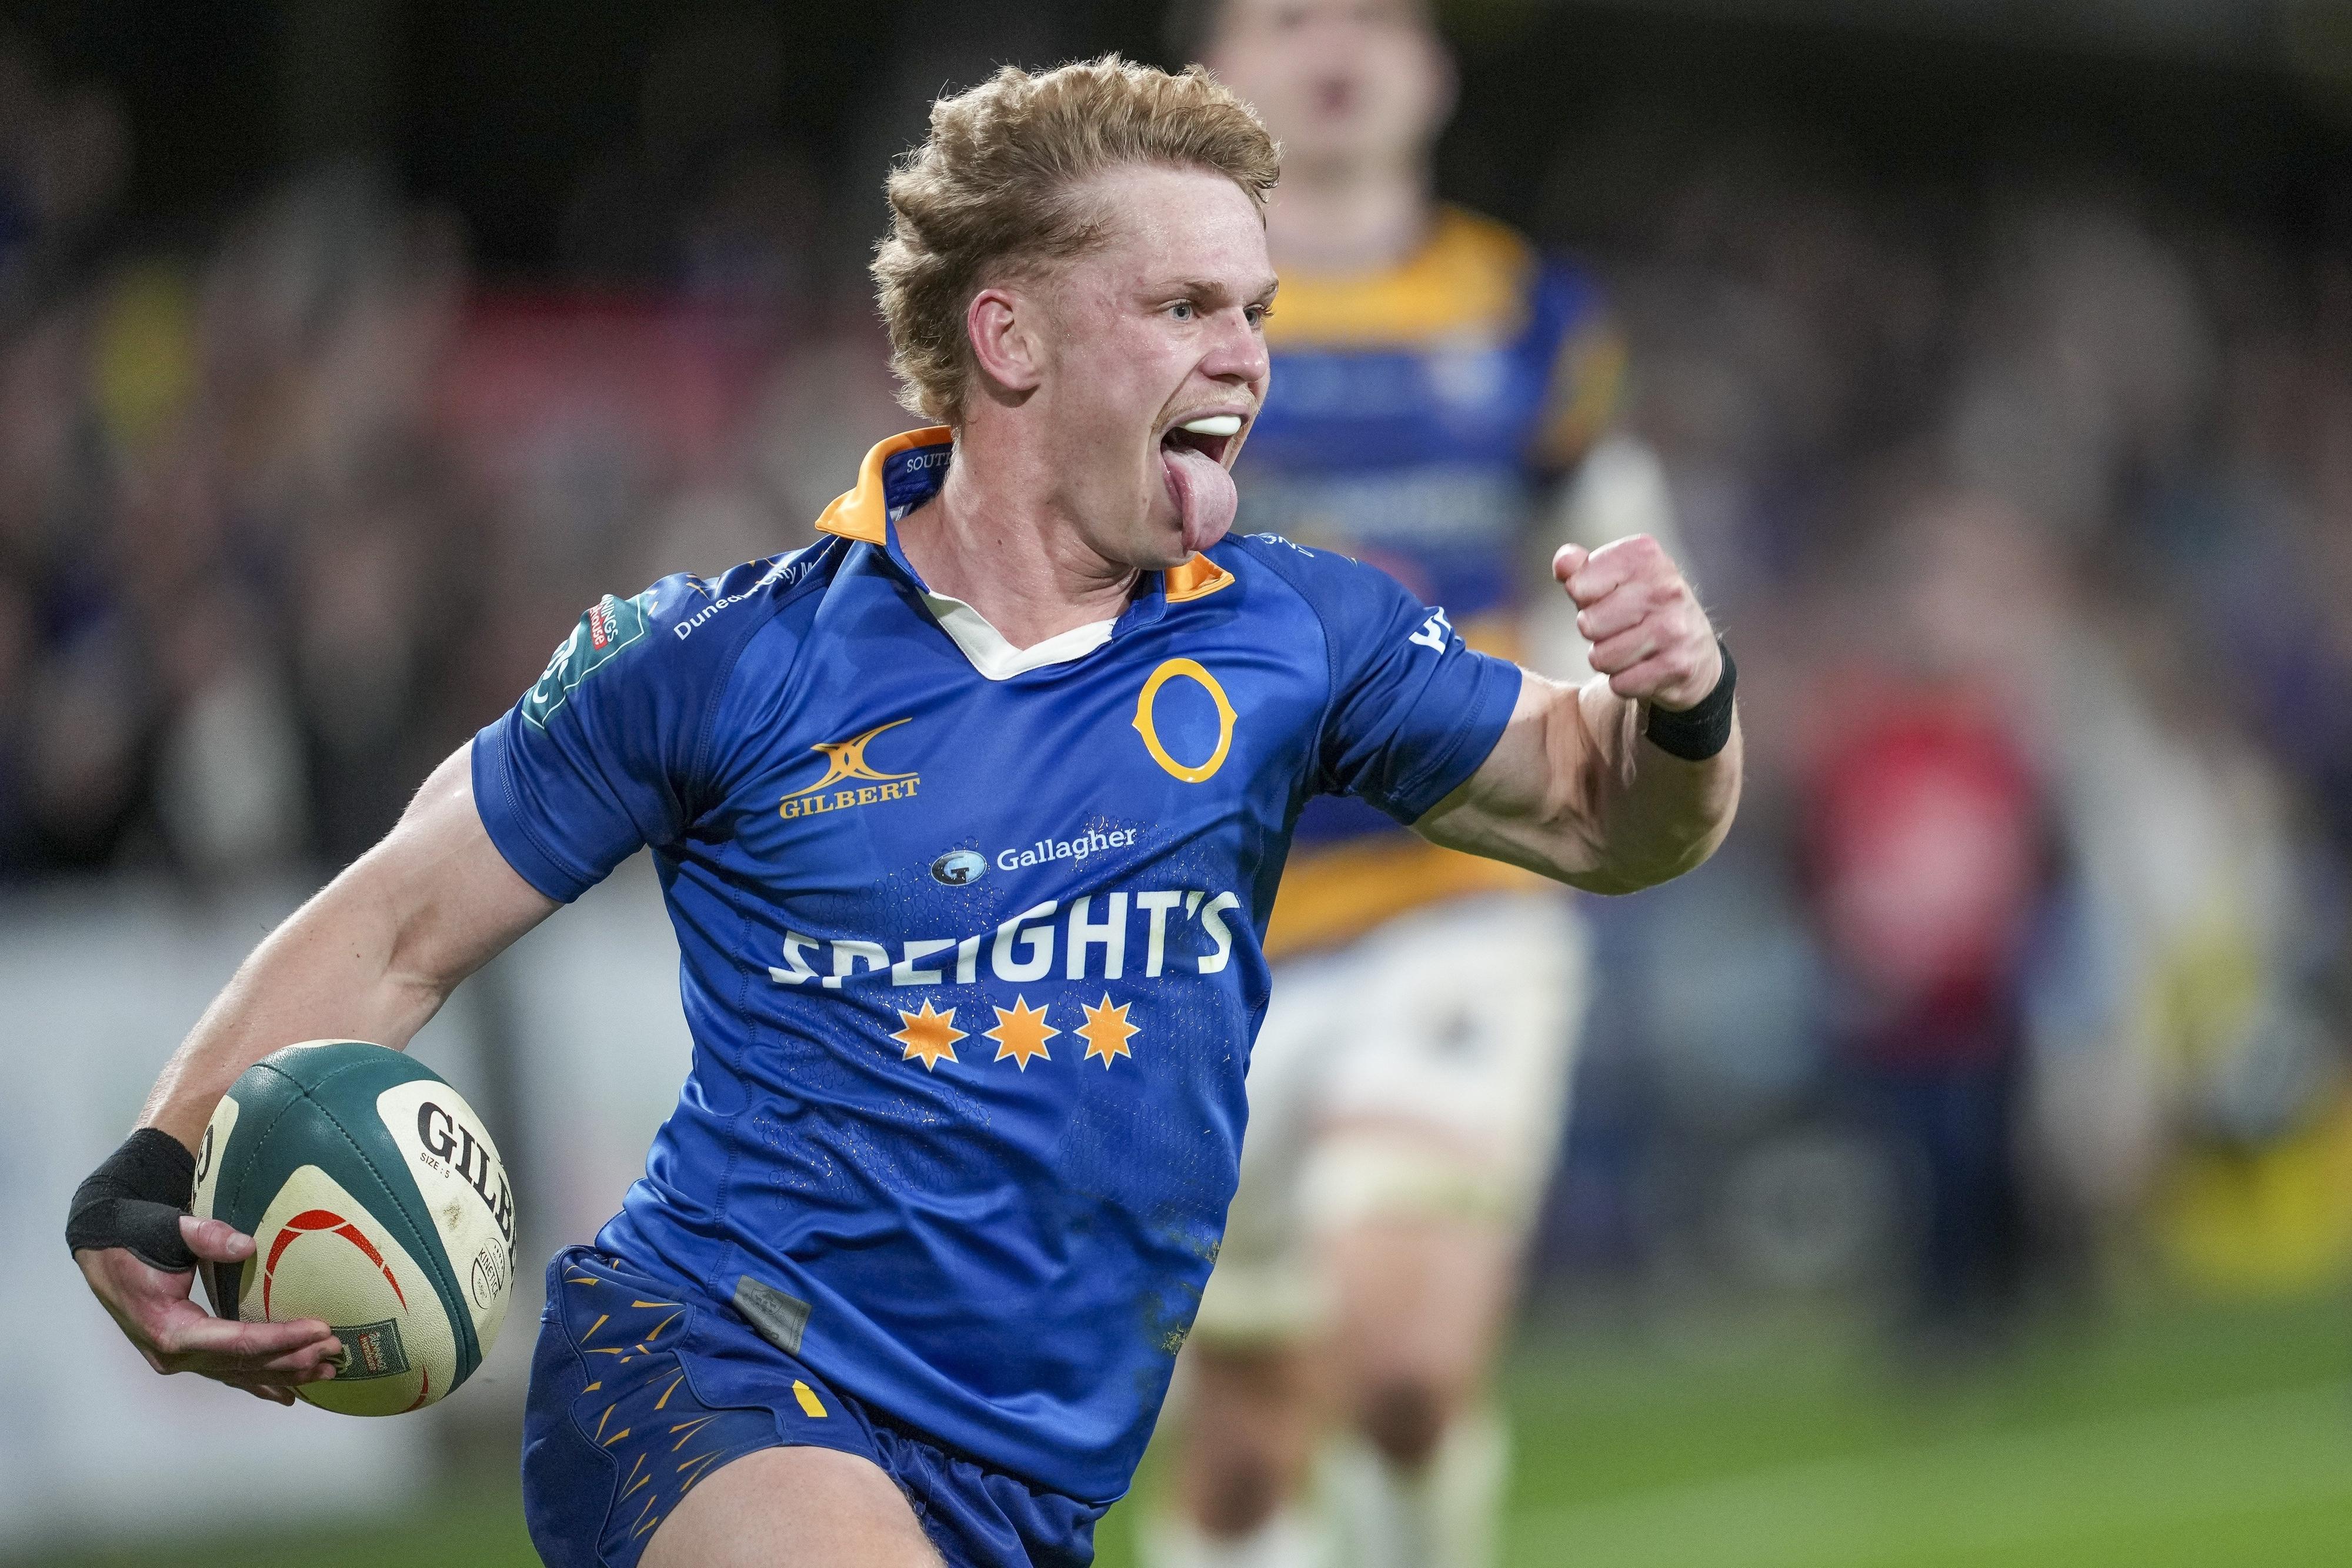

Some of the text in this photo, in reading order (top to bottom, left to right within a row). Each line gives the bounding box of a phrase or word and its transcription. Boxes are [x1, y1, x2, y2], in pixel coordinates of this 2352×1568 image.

[673, 588, 759, 640] Duned
[779, 778, 920, 819] GILBERT
[997, 828, 1137, 871] Gallagher
[418, 1102, 516, 1282] GILB
[478, 1247, 498, 1301] KINETICA
